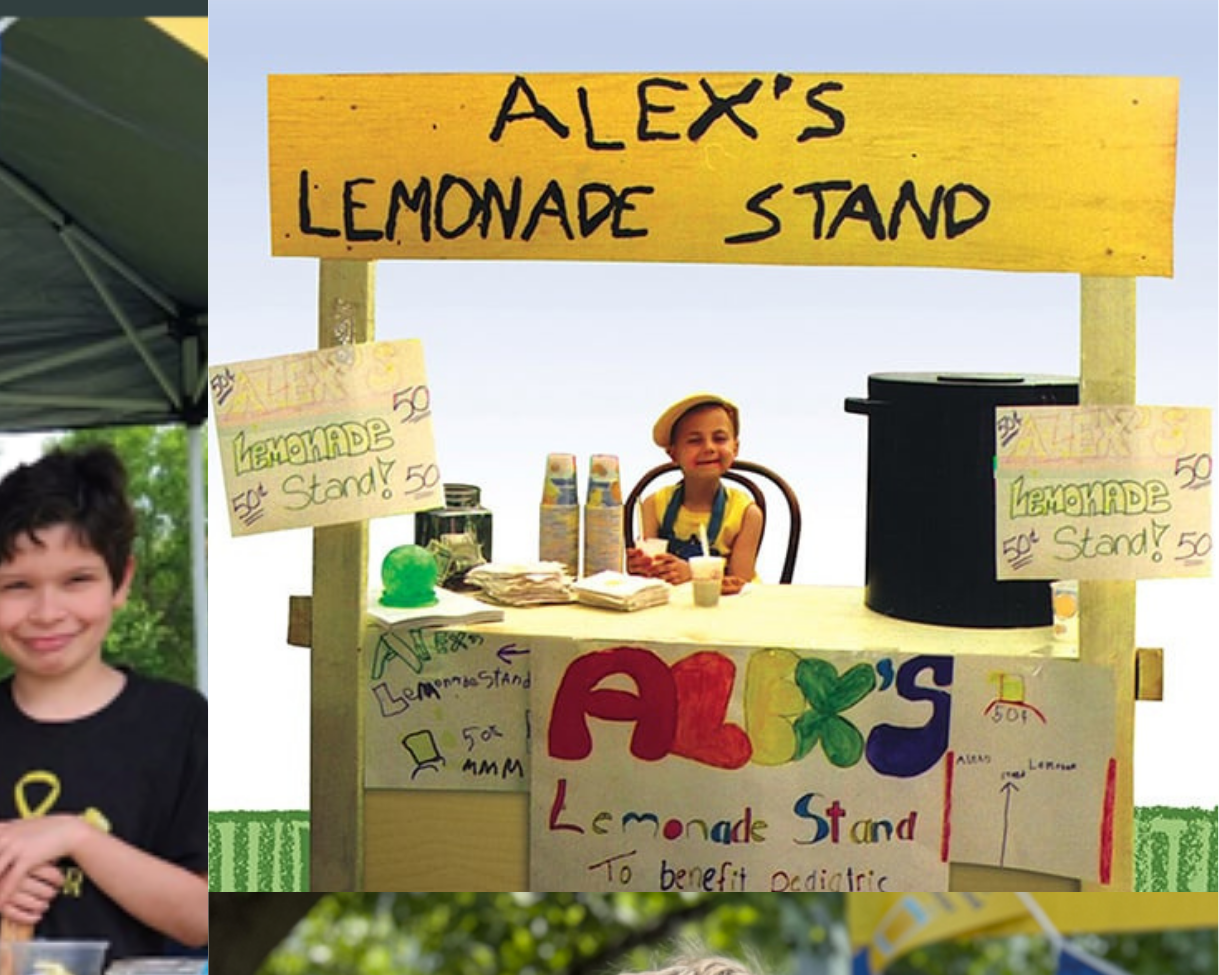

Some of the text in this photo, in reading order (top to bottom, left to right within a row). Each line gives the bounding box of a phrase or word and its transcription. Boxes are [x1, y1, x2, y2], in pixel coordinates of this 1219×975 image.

[488, 75, 847, 150] ALEX'S
[298, 169, 991, 246] LEMONADE STAND
[393, 385, 430, 423] 50
[234, 418, 395, 476] LEMONADE
[1175, 453, 1213, 489] 50
[282, 456, 396, 510] Stand!
[405, 464, 440, 495] 50
[1010, 475, 1172, 519] LEMONADE
[1054, 518, 1170, 563] Stand!
[1174, 531, 1213, 561] 50
[548, 646, 954, 778] ALEX'S
[549, 778, 918, 845] Lemonade Stand
[588, 850, 637, 885] To
[659, 860, 748, 892] benefit
